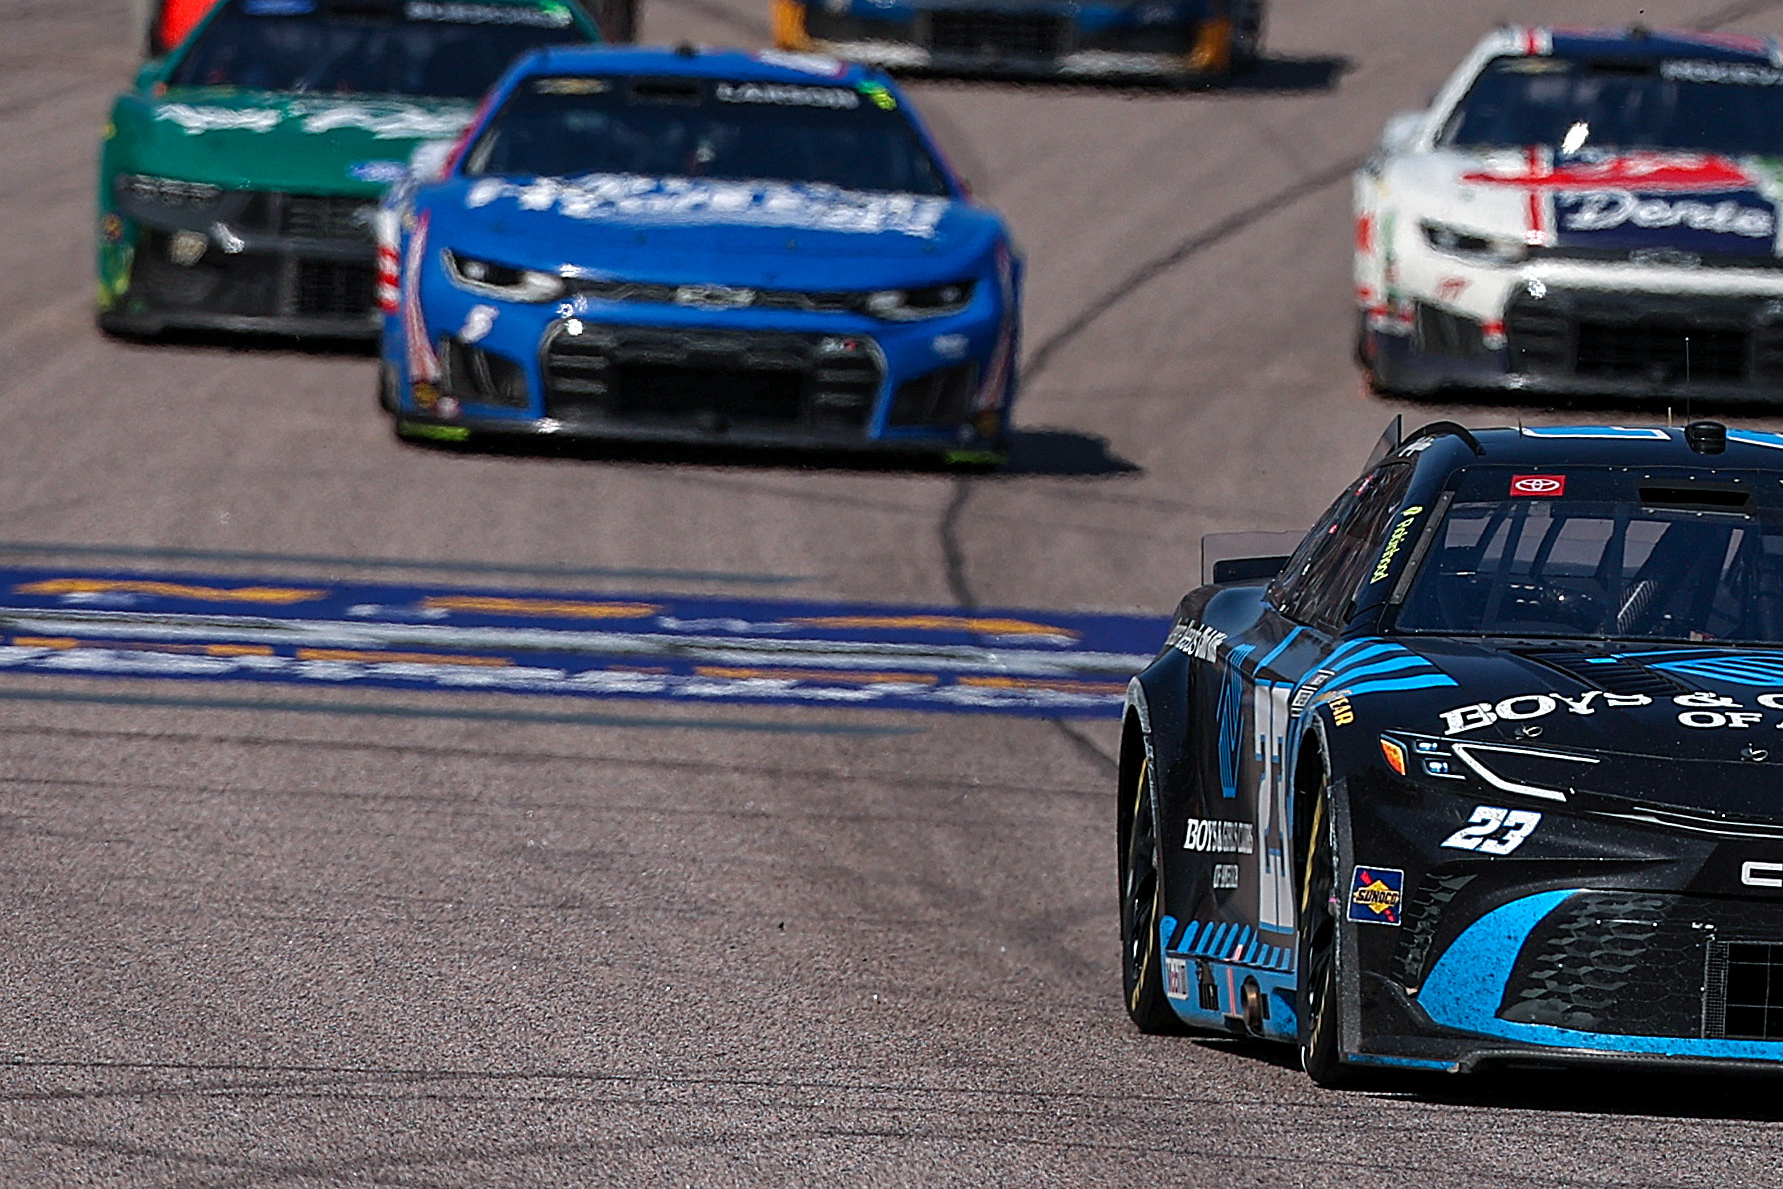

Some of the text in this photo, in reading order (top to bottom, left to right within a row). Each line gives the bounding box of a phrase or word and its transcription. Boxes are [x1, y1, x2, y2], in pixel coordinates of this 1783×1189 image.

[1439, 690, 1654, 736] BOYS
[1673, 690, 1744, 710] &
[1677, 710, 1764, 729] OF
[1440, 805, 1543, 856] 23
[1356, 889, 1398, 905] SUNOCO
